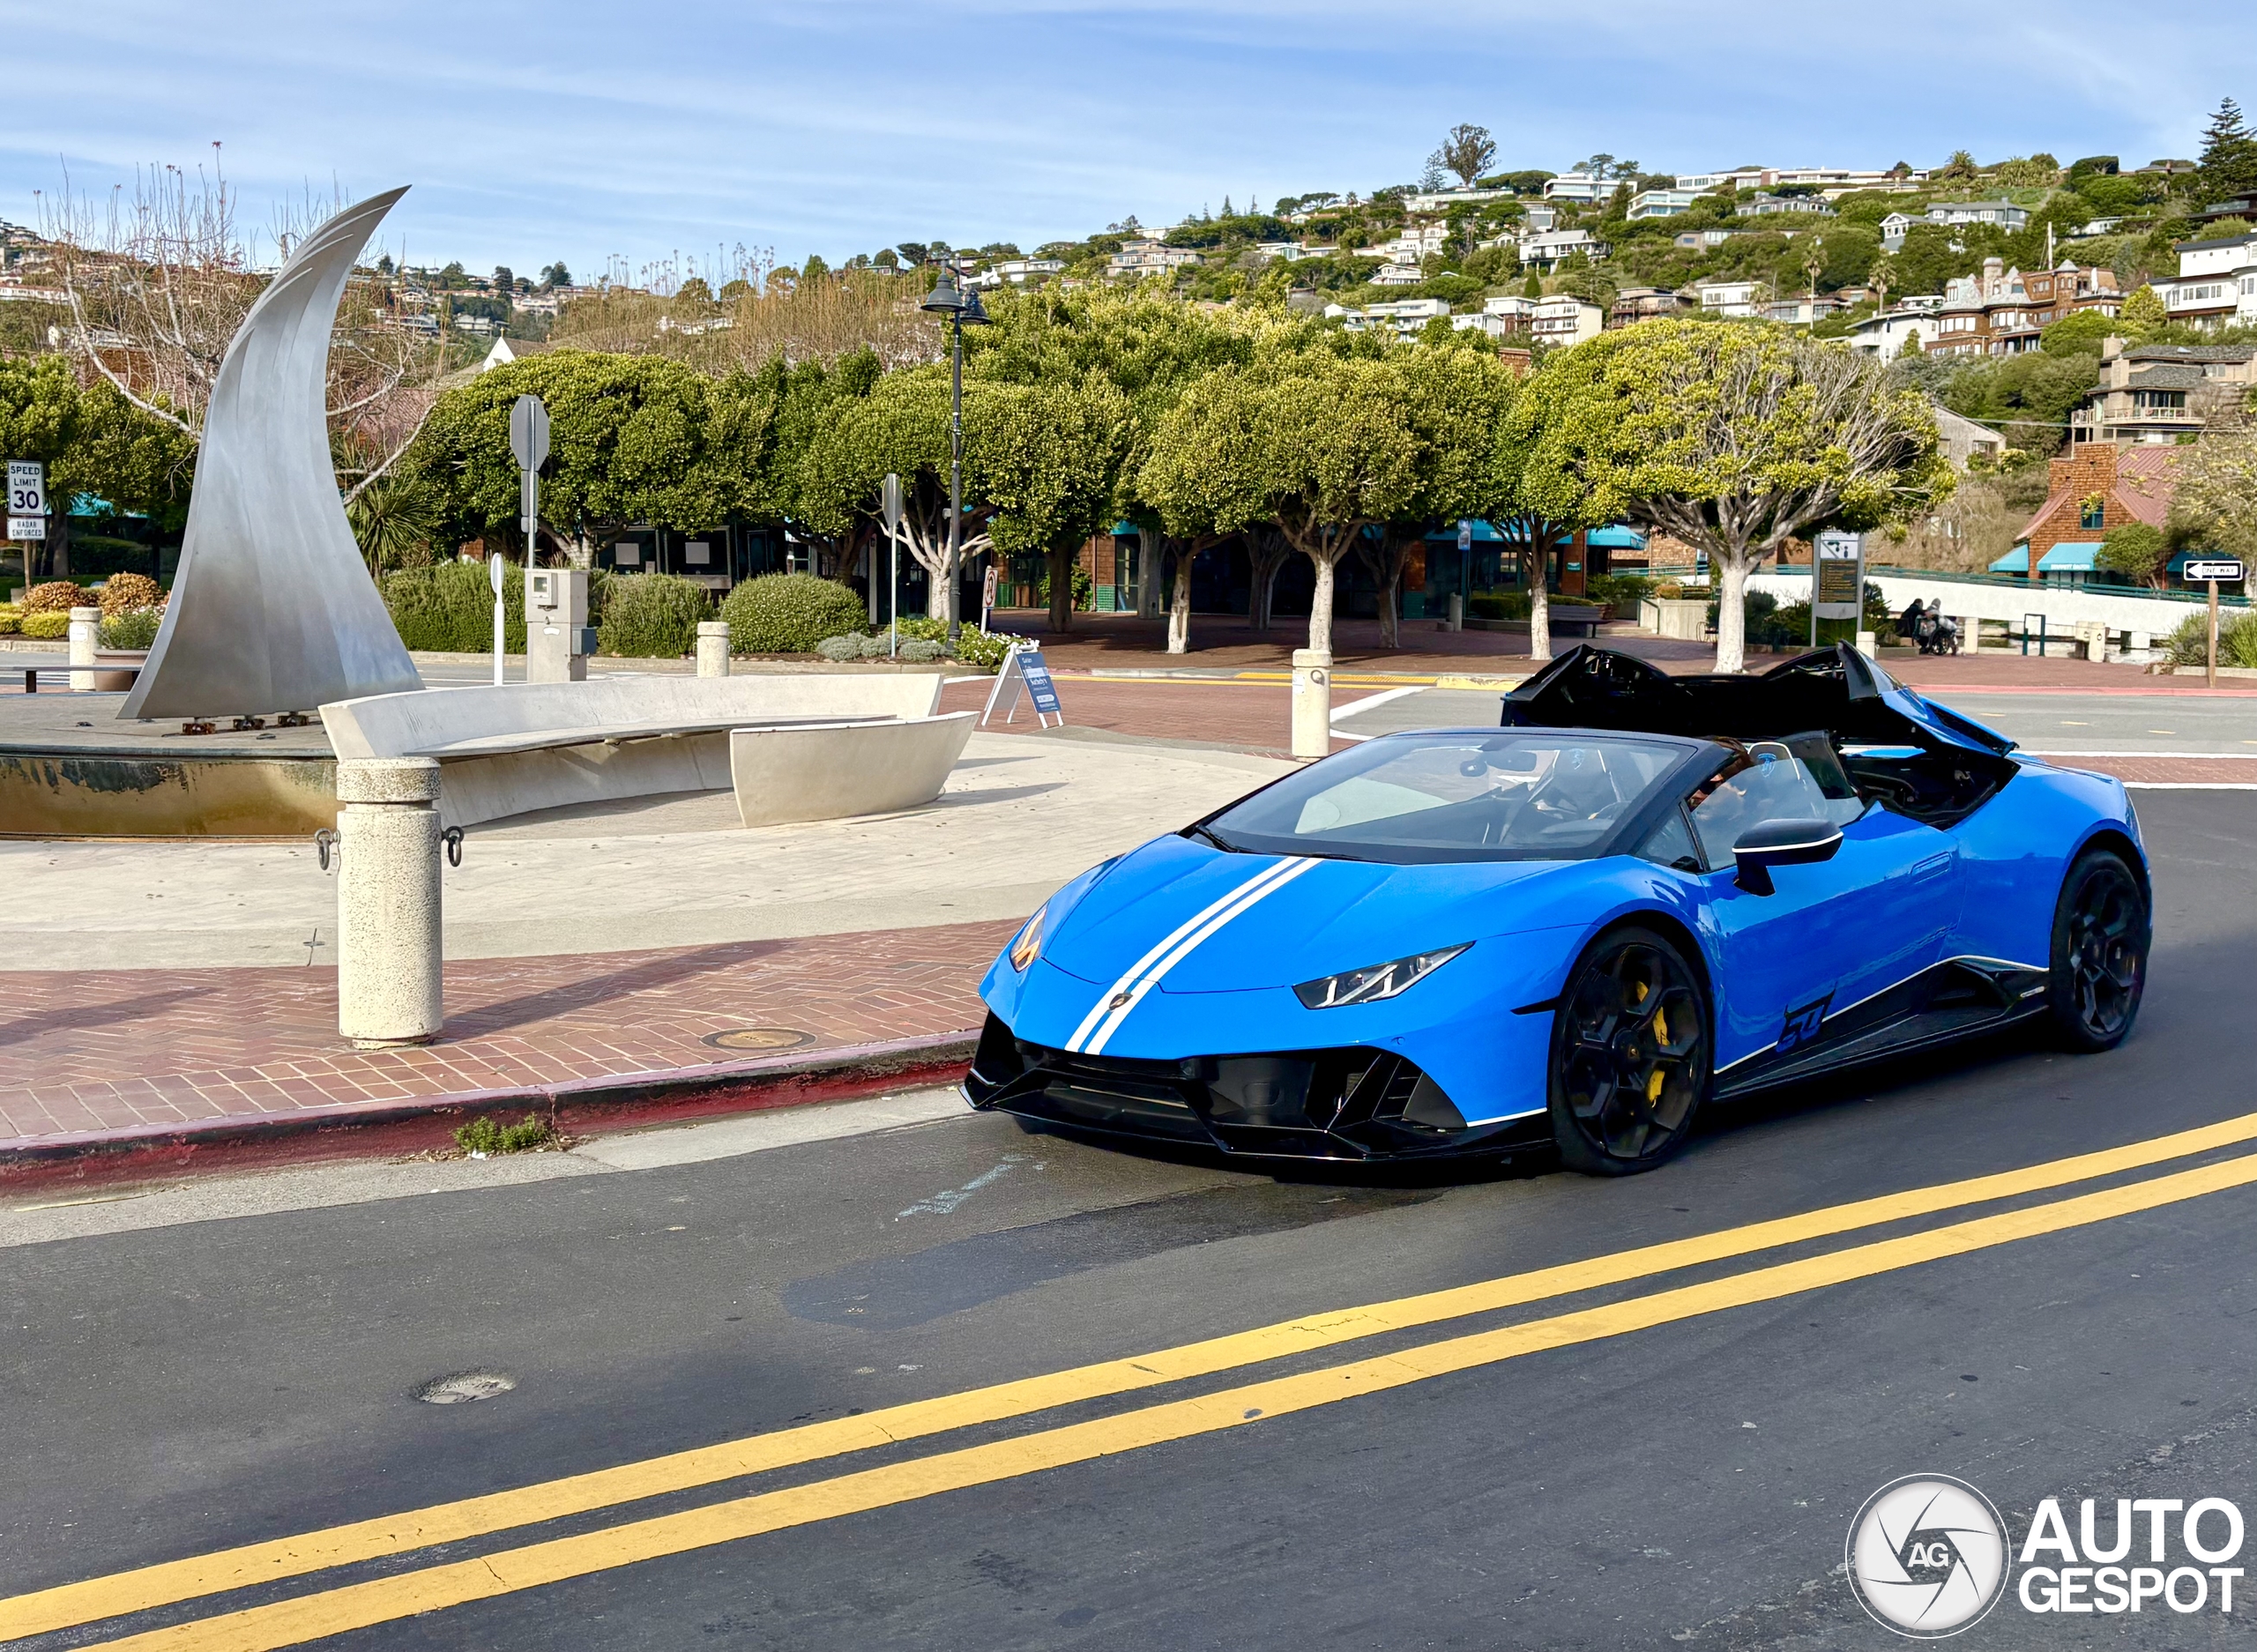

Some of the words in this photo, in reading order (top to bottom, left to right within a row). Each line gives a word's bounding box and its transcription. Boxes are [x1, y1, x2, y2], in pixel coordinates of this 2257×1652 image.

[11, 465, 41, 475] SPEED
[14, 478, 37, 487] LIMIT
[13, 490, 40, 510] 30
